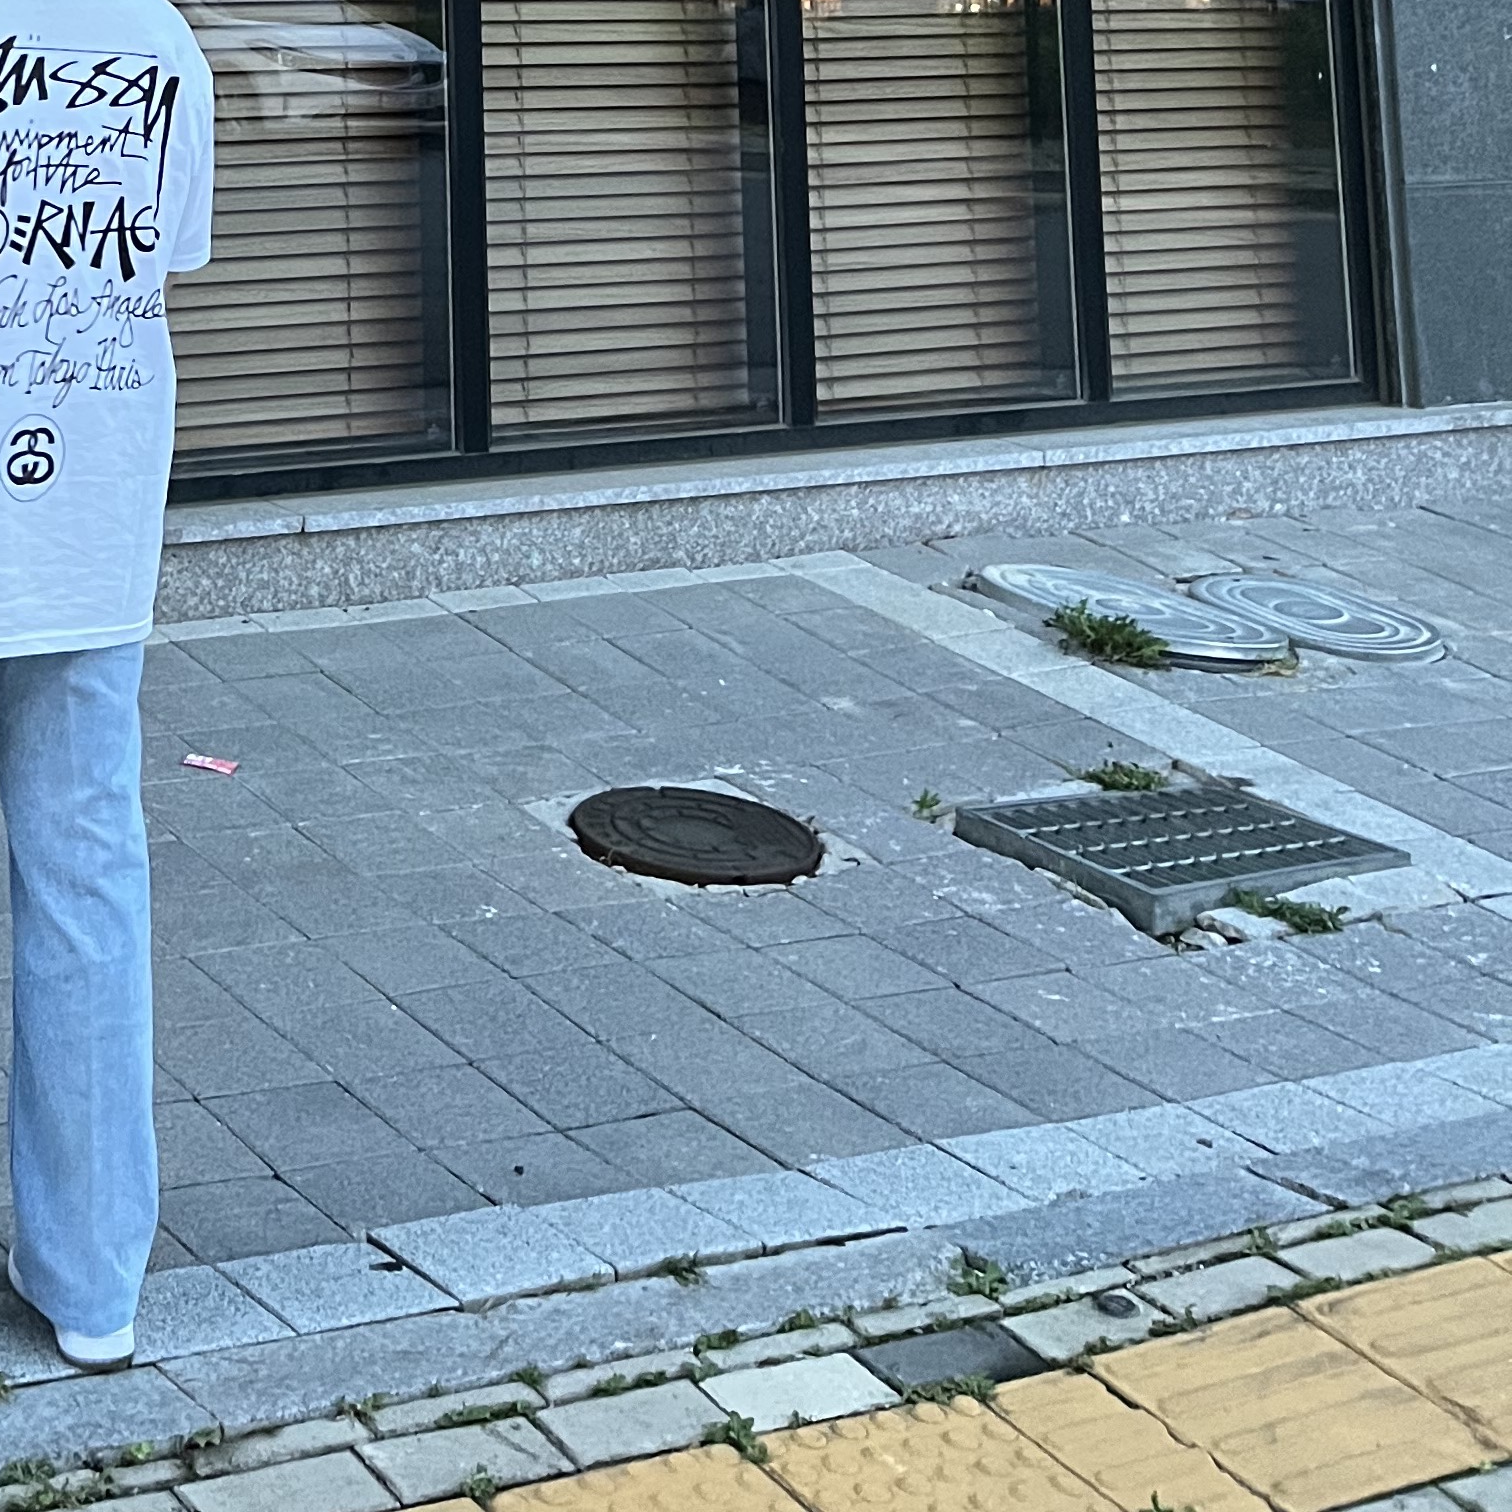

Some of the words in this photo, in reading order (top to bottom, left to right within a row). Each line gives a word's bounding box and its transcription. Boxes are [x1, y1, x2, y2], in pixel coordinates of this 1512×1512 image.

[33, 275, 89, 345] Los
[16, 337, 92, 408] Tokyo
[89, 337, 155, 391] Paris
